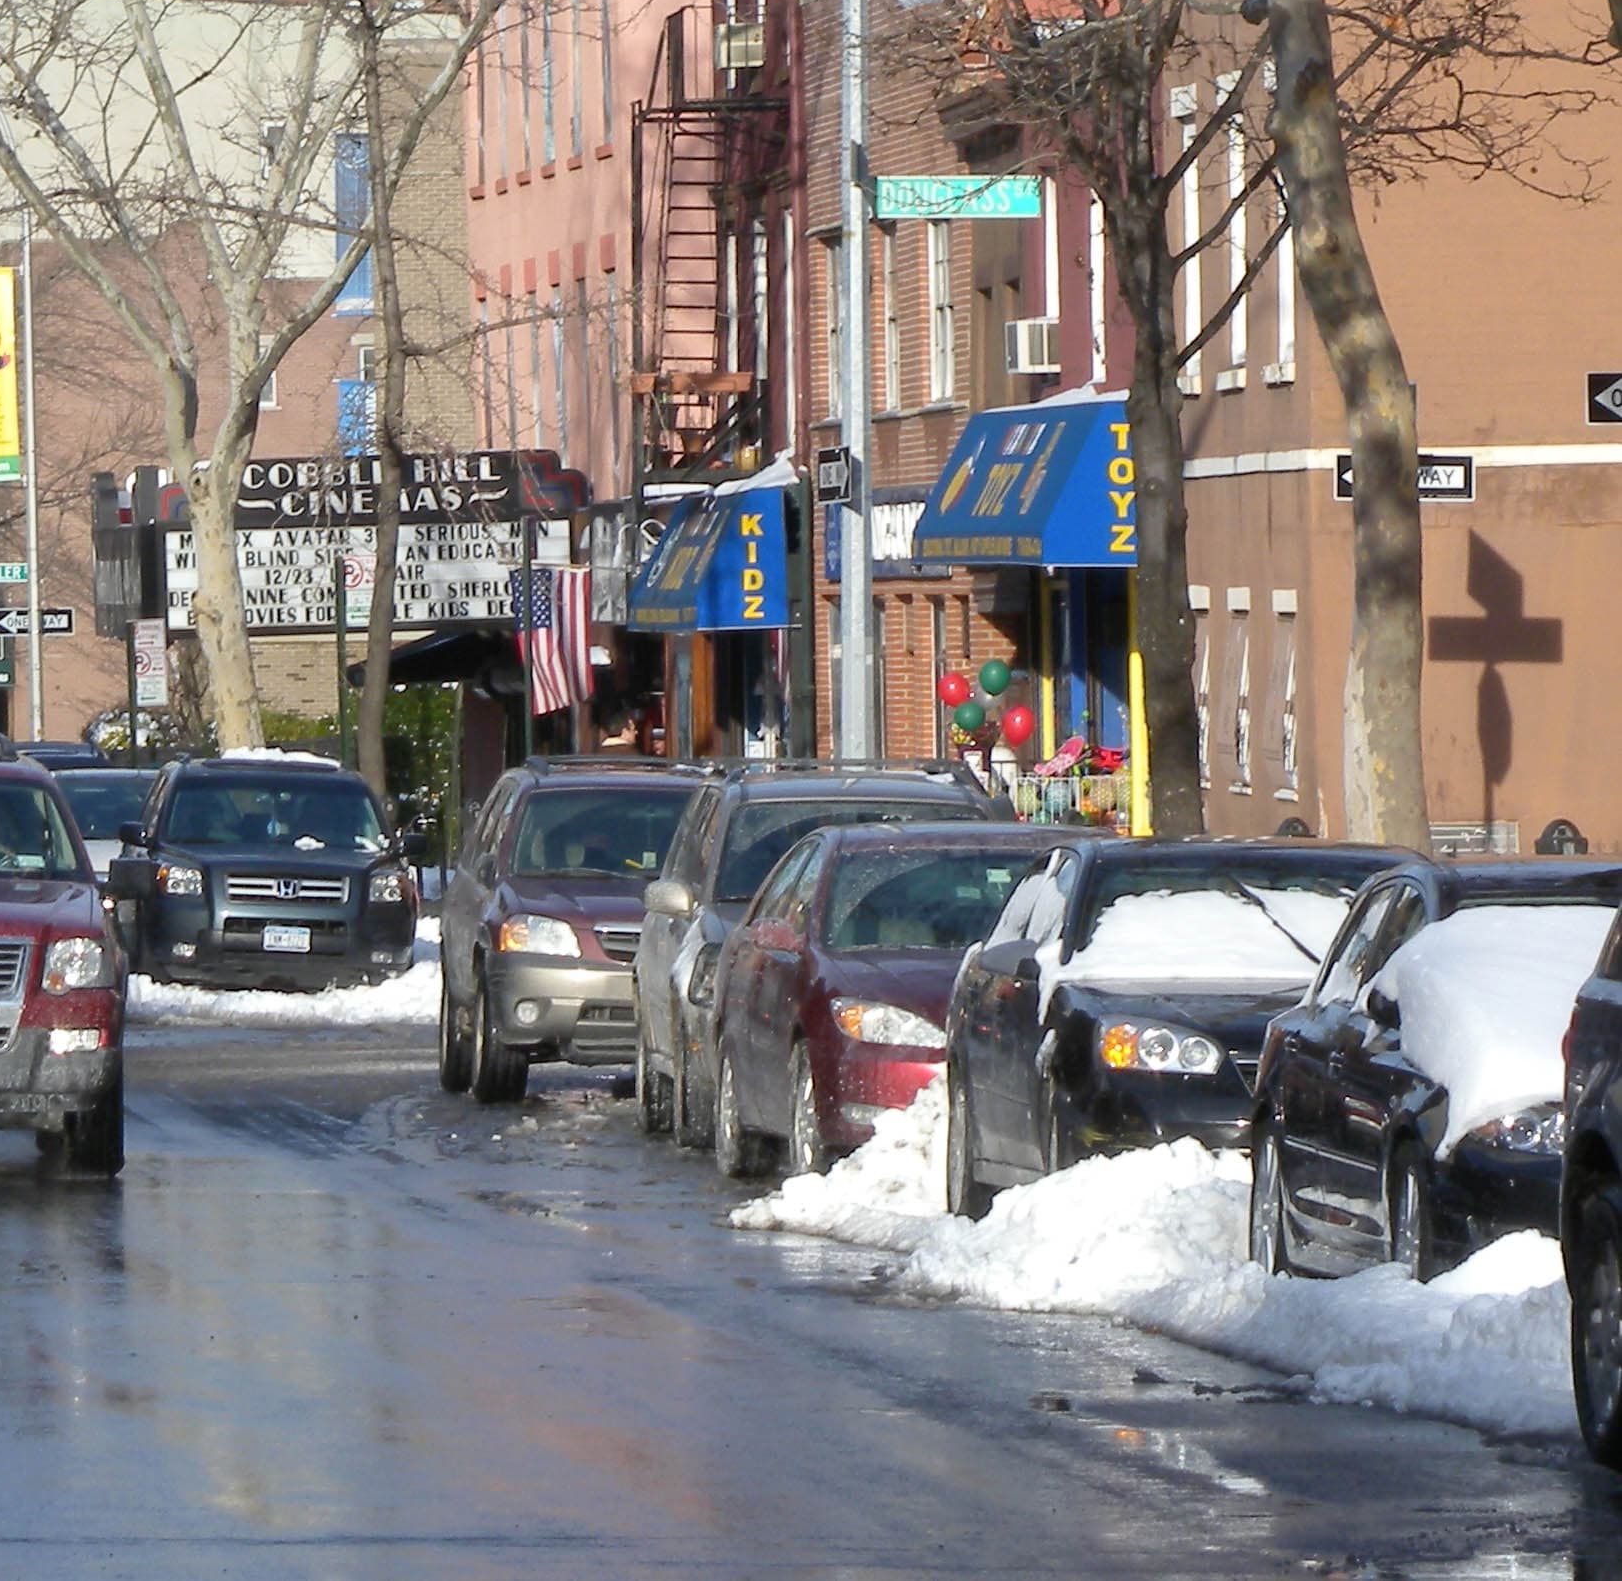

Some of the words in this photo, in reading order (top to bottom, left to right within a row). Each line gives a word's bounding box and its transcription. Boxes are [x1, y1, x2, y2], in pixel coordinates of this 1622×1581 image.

[881, 181, 1011, 212] DOUGLASS
[413, 456, 502, 484] HILL
[1110, 423, 1135, 553] TOYZ
[273, 528, 351, 546] AVATAR
[415, 523, 492, 541] SERIOUS
[246, 550, 299, 567] BLIND
[405, 546, 429, 561] AN
[740, 514, 765, 620] KIDZ
[265, 569, 312, 585] 12/23
[246, 586, 289, 605] NINE
[245, 607, 297, 623] OVIES
[428, 601, 470, 619] KIDS
